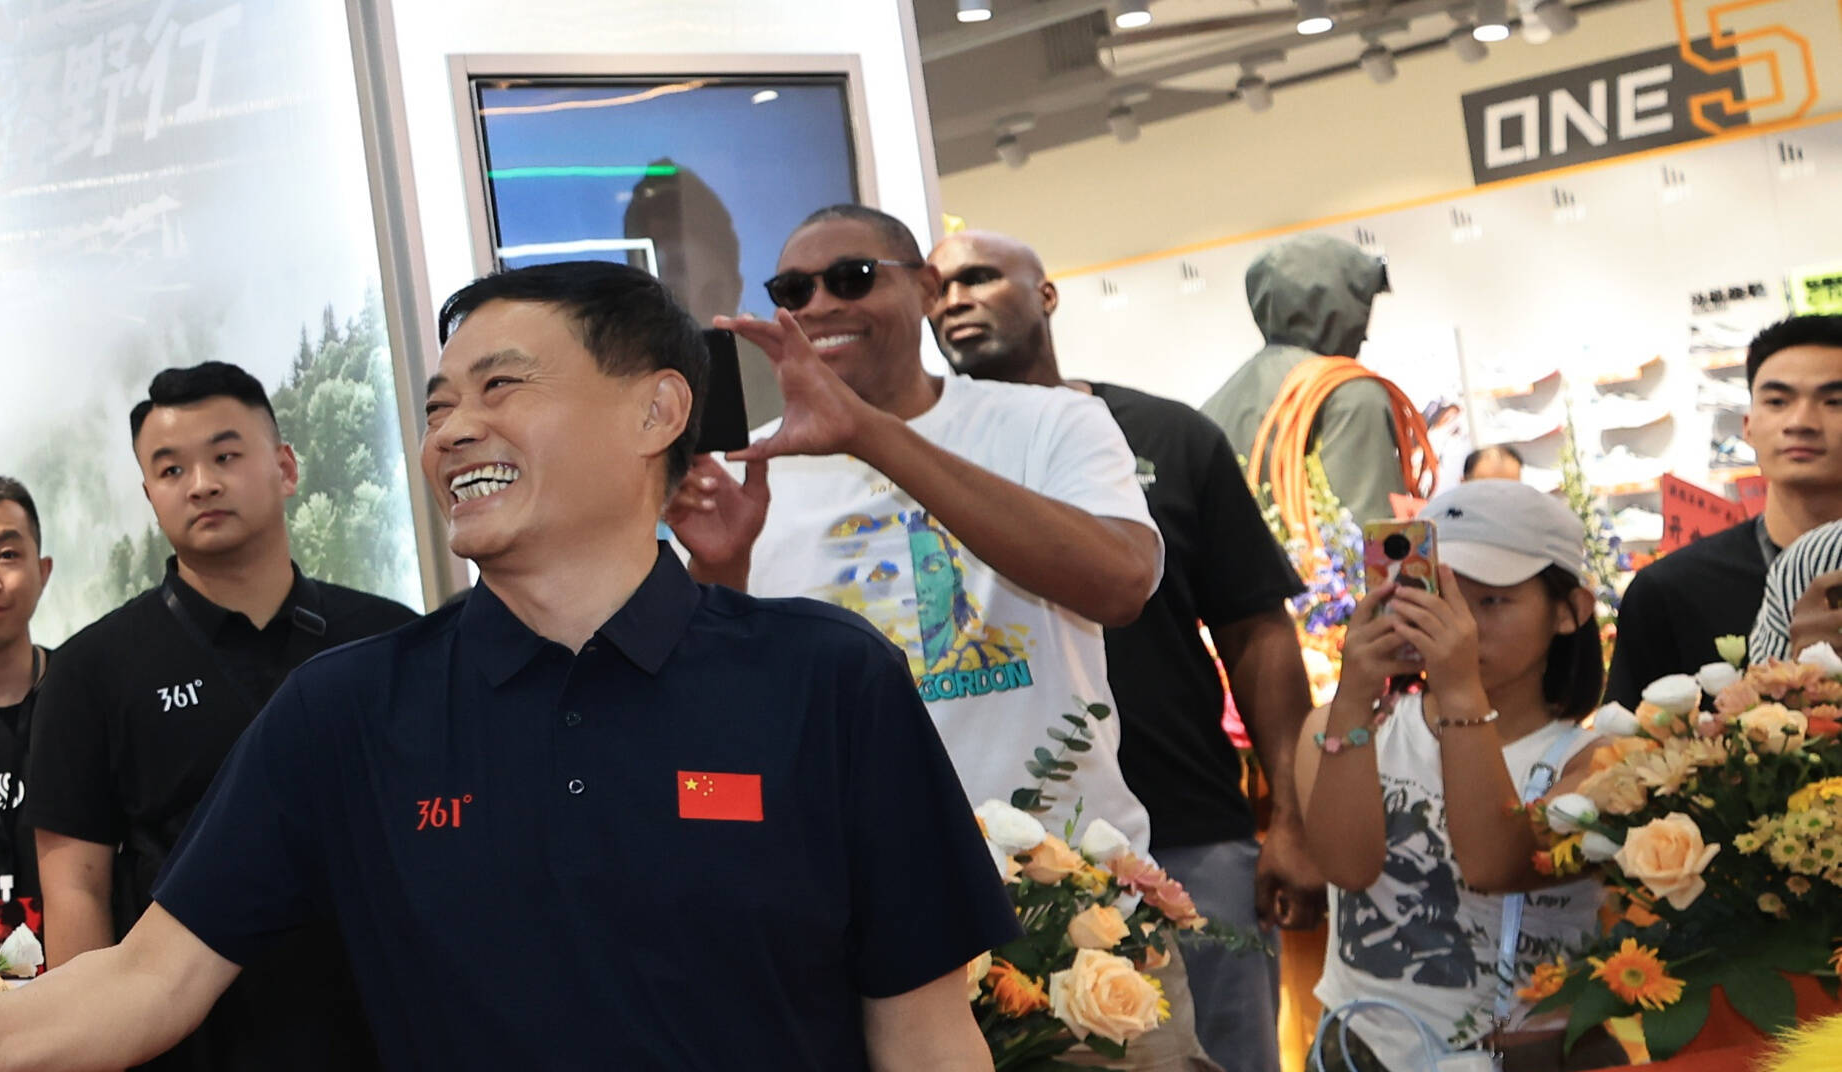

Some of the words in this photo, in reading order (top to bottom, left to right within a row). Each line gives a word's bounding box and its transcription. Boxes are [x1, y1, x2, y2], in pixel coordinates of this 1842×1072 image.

[1484, 64, 1674, 169] ONE
[157, 678, 203, 712] 361°
[919, 658, 1034, 703] GORDON
[416, 793, 473, 831] 361°
